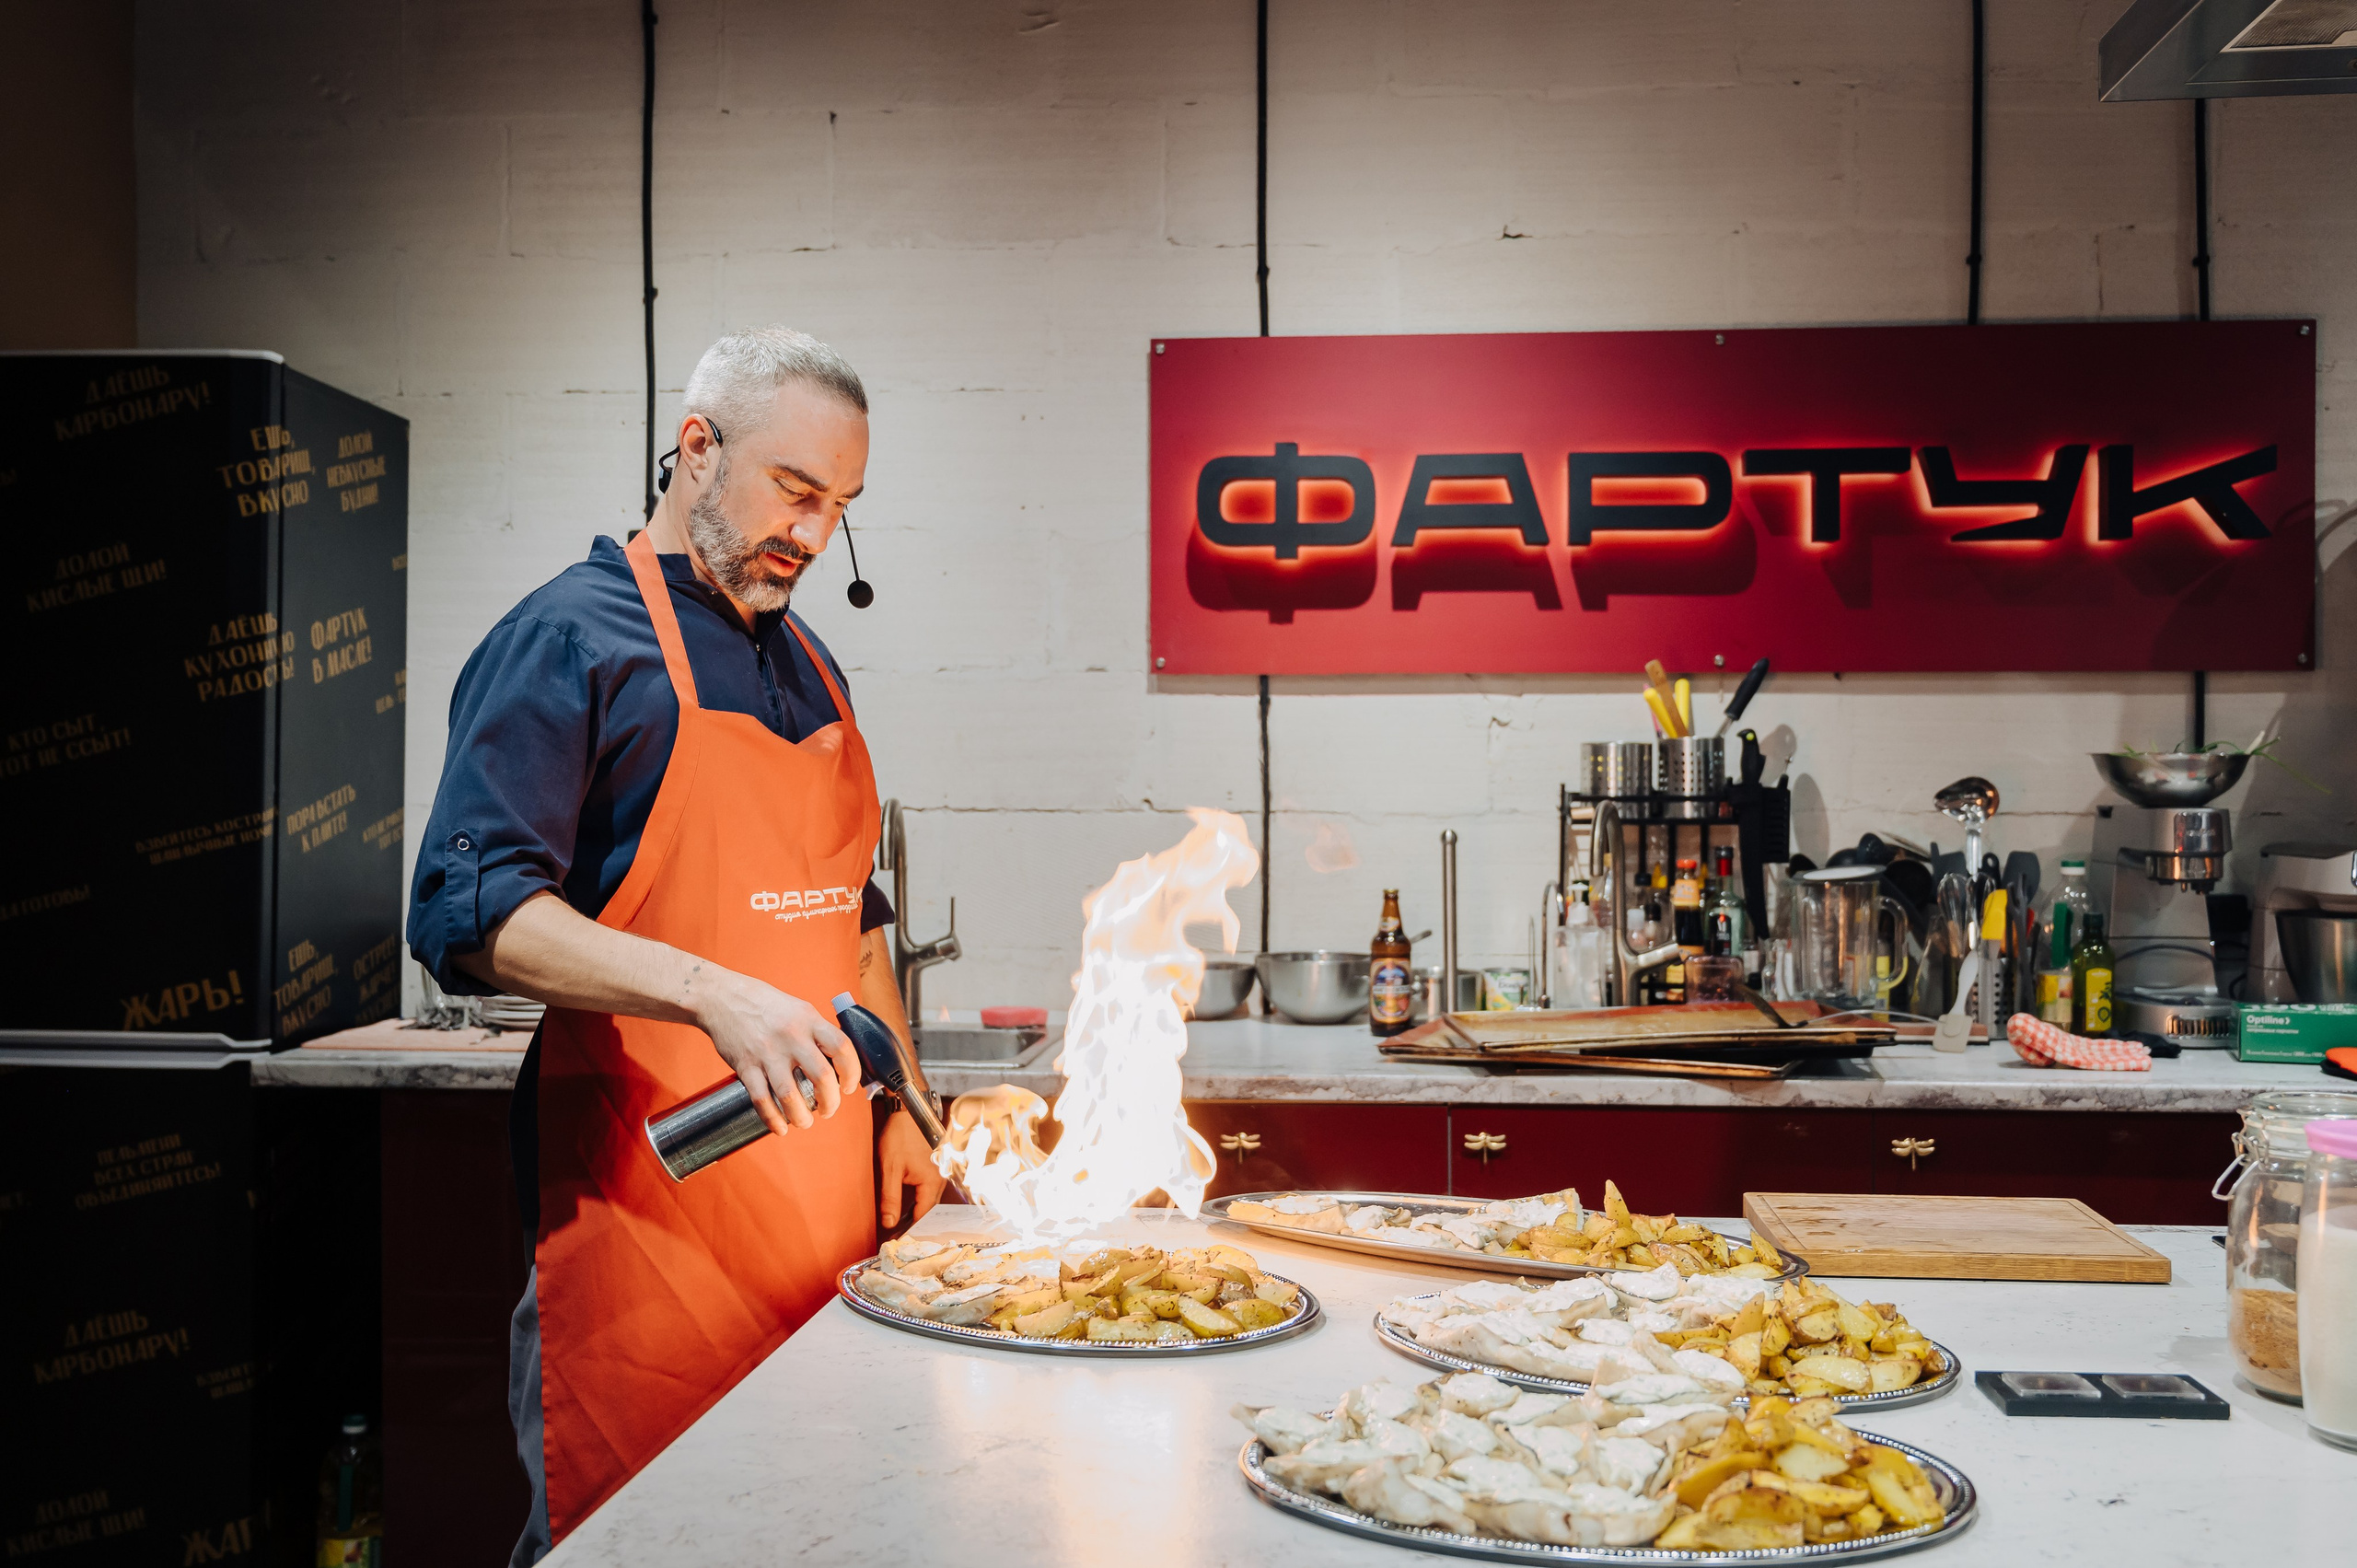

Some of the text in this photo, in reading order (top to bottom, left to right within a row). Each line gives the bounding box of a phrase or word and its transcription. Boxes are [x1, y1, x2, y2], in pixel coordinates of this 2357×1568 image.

[53, 379, 211, 443] КАРБОНАРУ!
[237, 479, 309, 517] ВКУСНО
[1197, 442, 2278, 561] ФАРТУК
[119, 969, 245, 1031] ЖАРЬ!
[2247, 1015, 2284, 1025] Optiline
